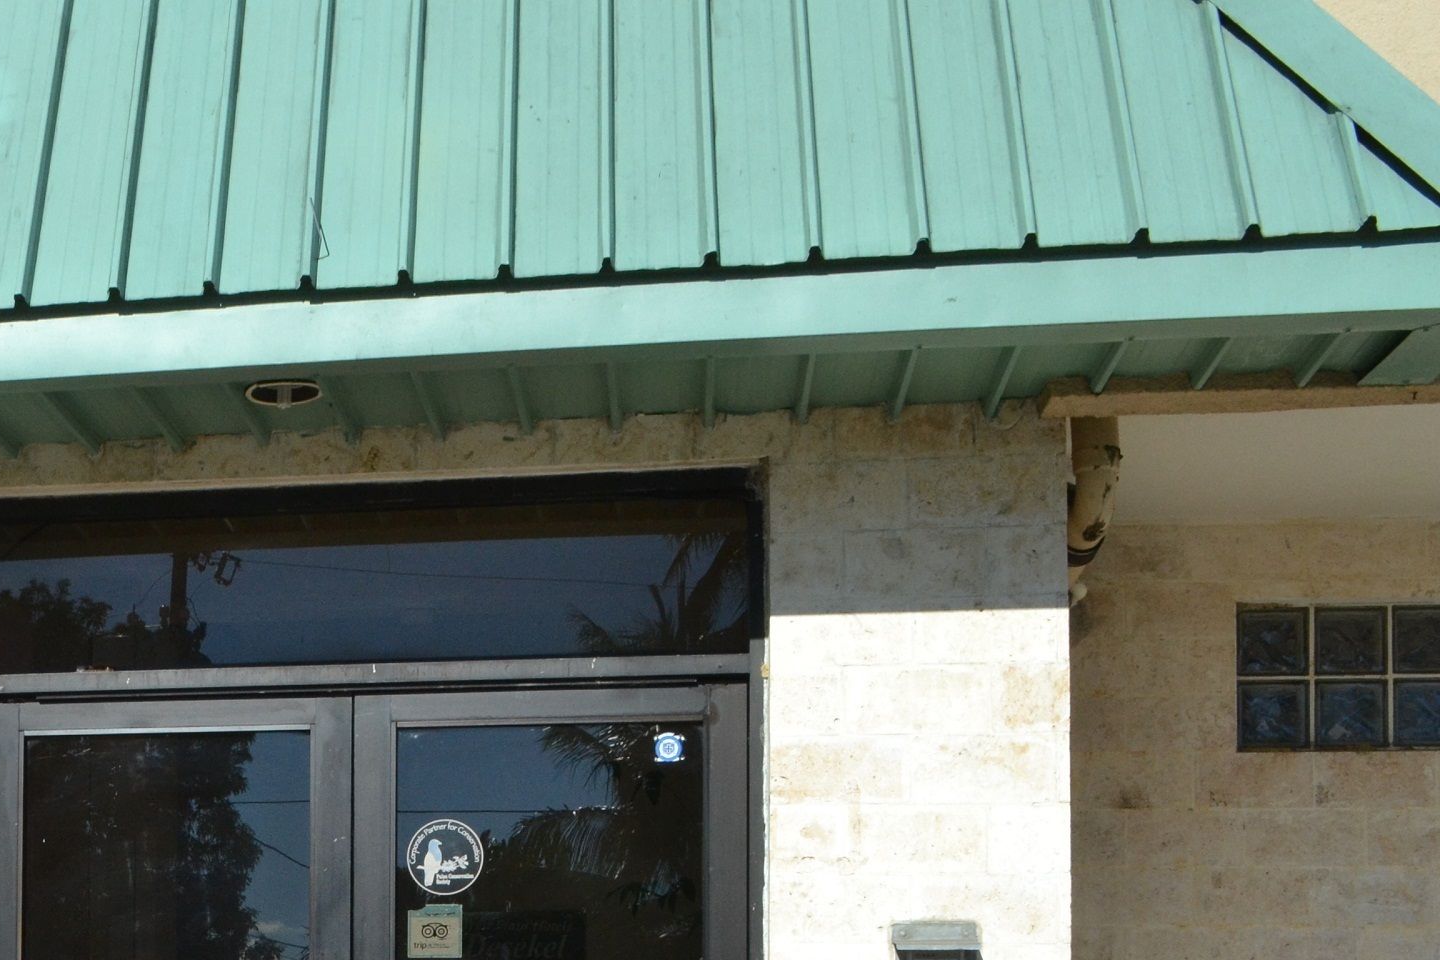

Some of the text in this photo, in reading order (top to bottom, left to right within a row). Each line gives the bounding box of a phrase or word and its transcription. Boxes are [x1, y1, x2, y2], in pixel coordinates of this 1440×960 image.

[423, 824, 447, 835] Partner
[447, 821, 458, 830] for
[457, 826, 480, 863] Conservation
